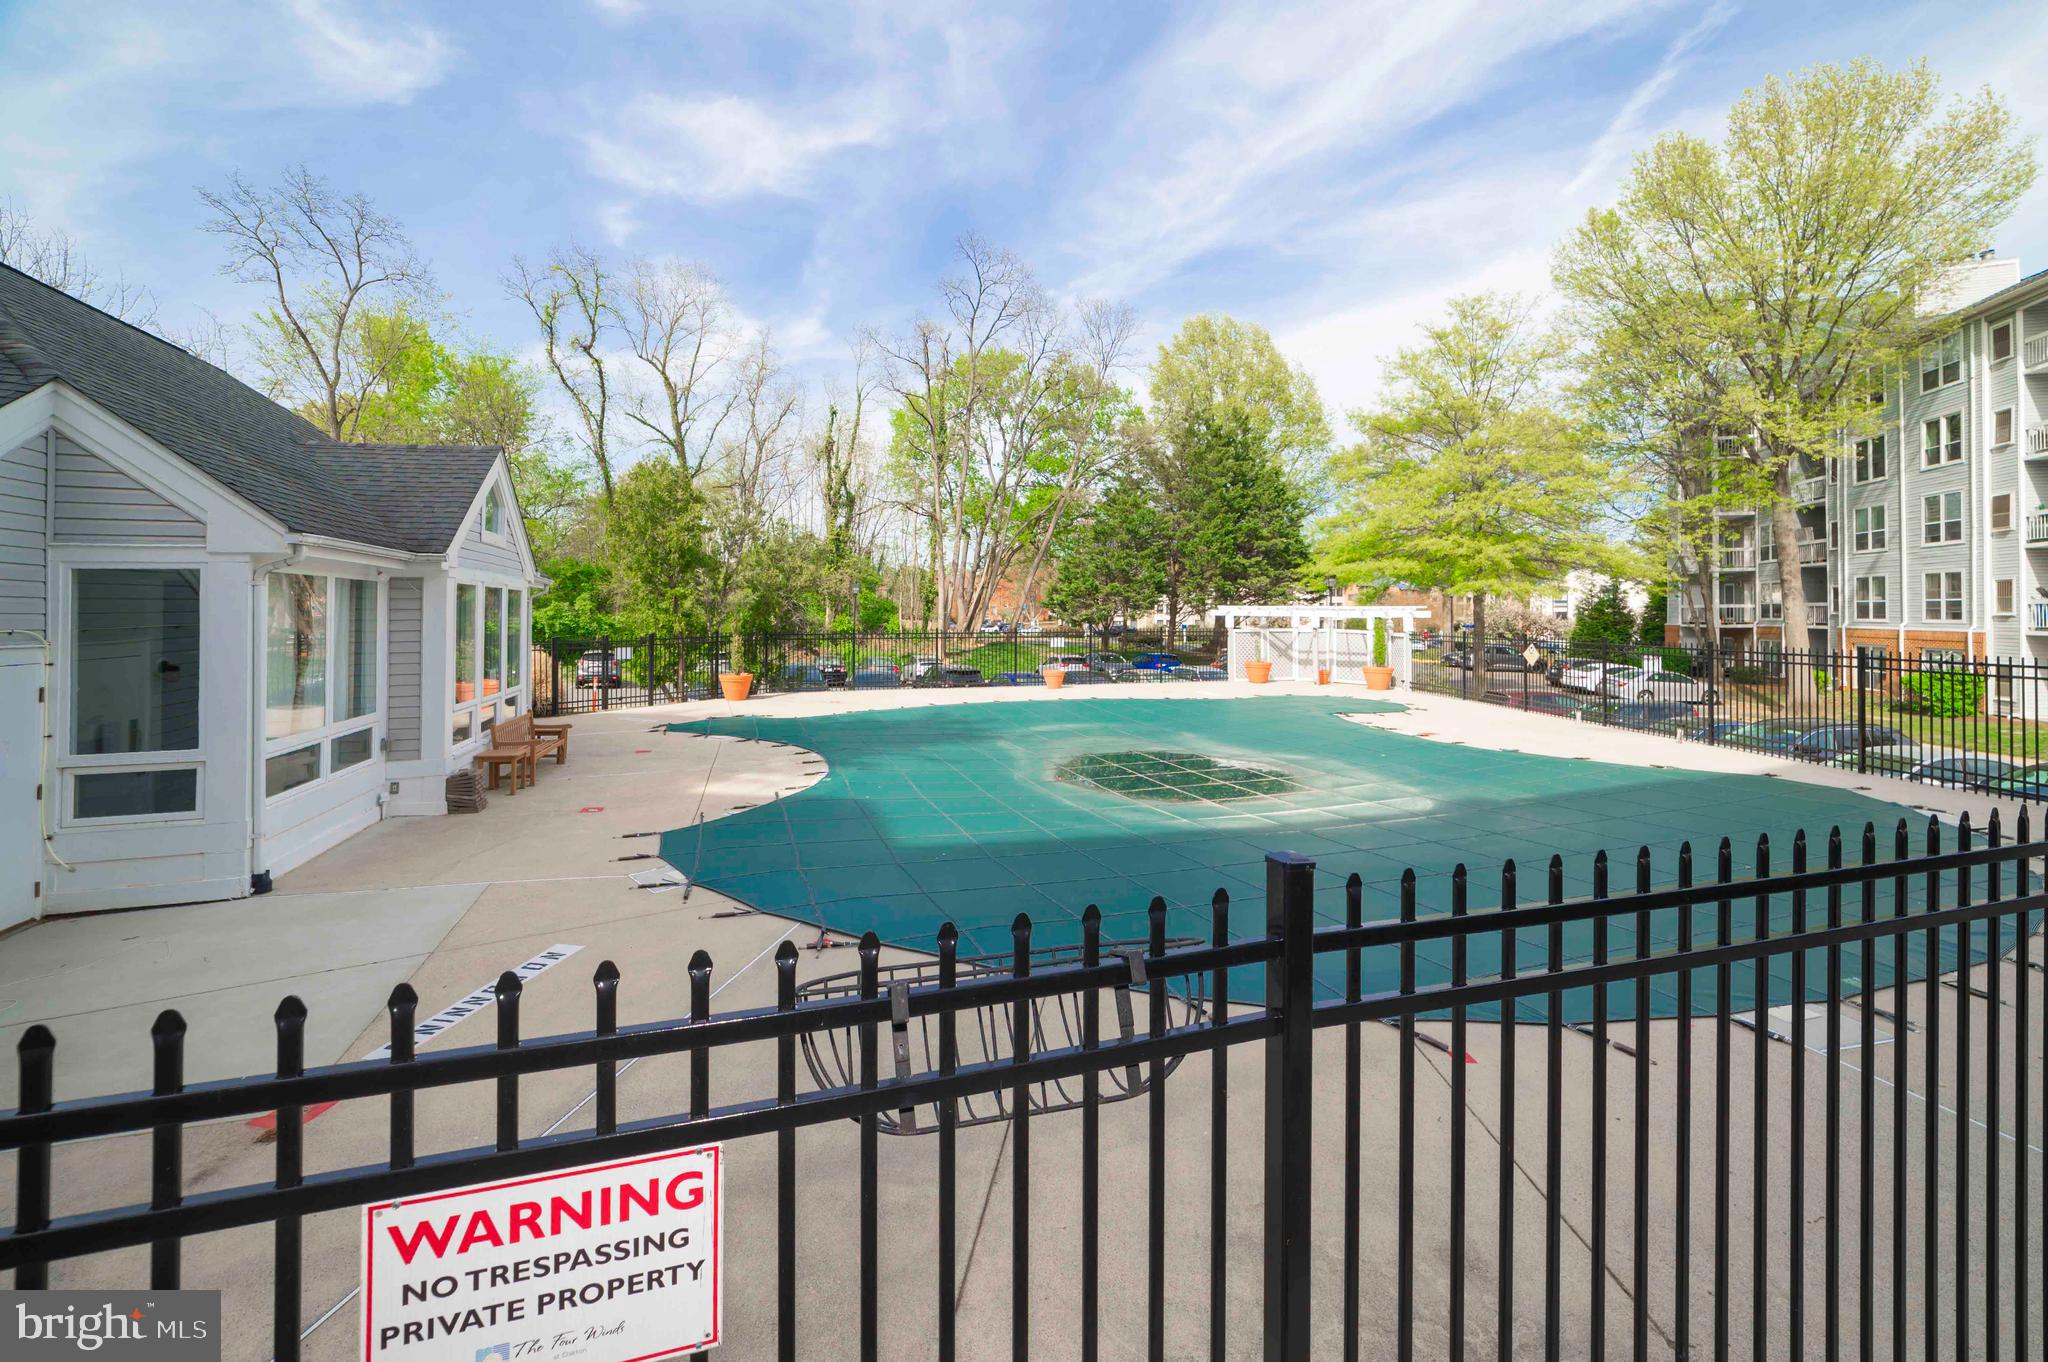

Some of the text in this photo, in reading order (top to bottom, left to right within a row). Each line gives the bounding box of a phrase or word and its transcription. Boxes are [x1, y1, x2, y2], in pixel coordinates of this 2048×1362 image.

[384, 951, 567, 1050] NO UNNIN
[387, 1171, 704, 1265] WARNING
[380, 1259, 706, 1350] PRIVATE PROPERTY
[402, 1227, 690, 1306] NO TRESPASSING
[512, 1320, 626, 1358] The Four Winds
